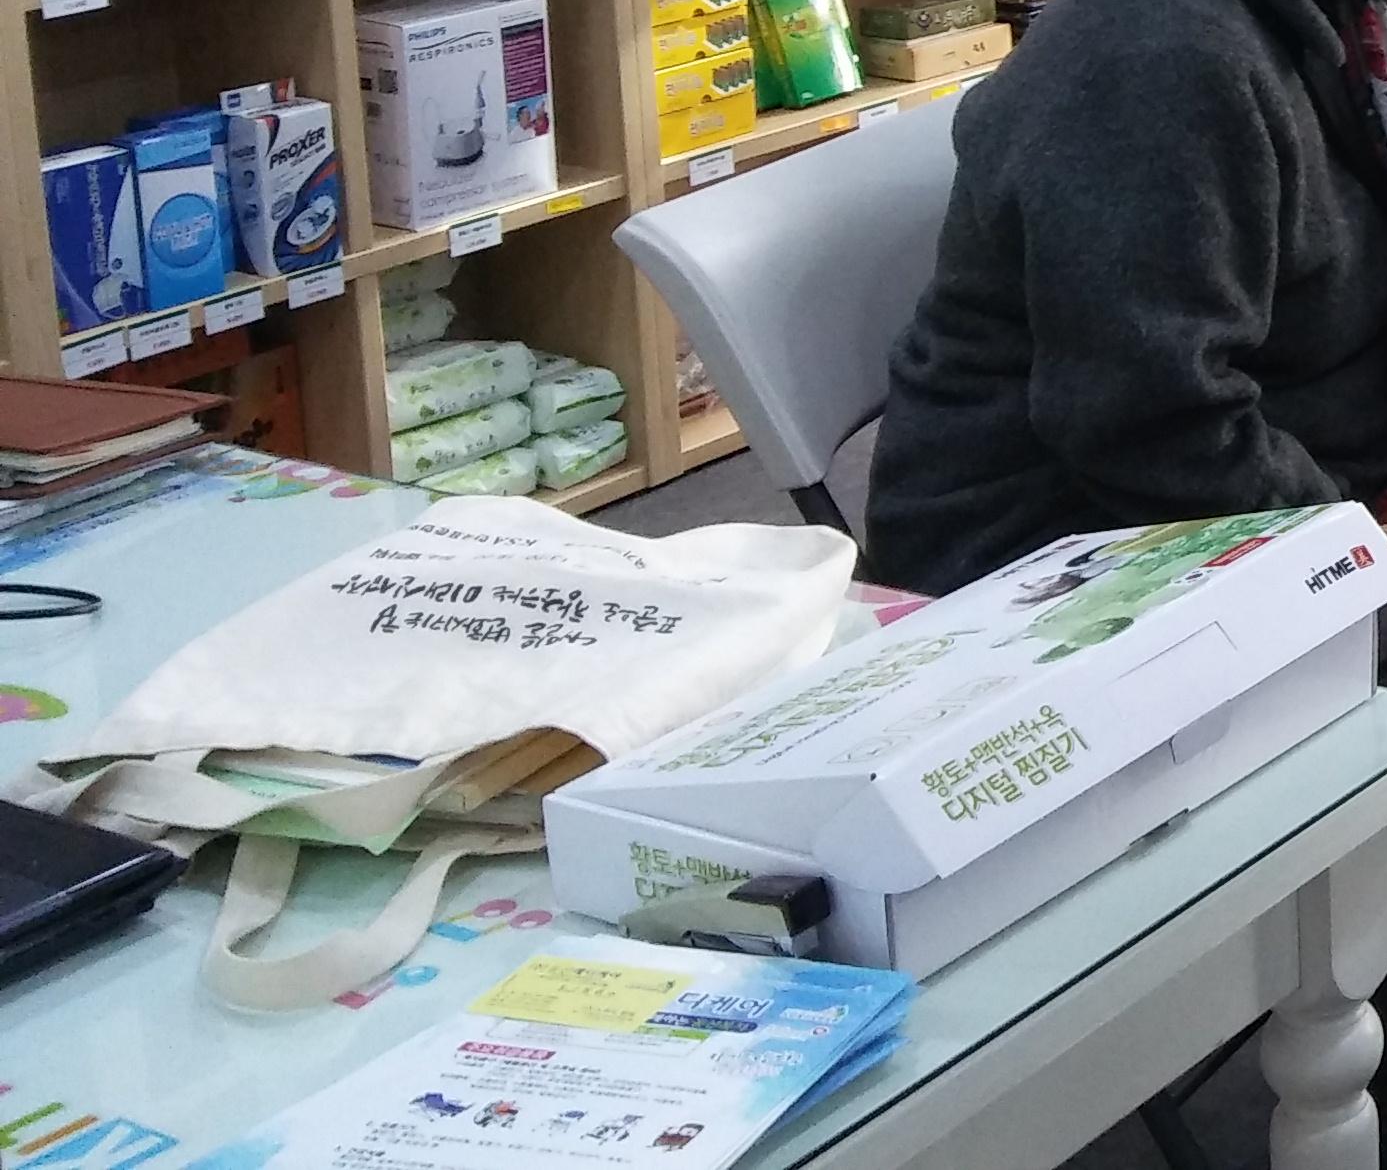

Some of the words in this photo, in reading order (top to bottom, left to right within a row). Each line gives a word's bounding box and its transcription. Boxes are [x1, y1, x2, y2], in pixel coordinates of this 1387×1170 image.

[408, 36, 495, 63] RESPIRONICS
[269, 126, 327, 171] PROXER
[1304, 556, 1357, 594] HITME
[921, 704, 1066, 798] 황토+맥반석+옥
[941, 768, 1025, 821] 디지털
[1013, 726, 1090, 786] 찜질기
